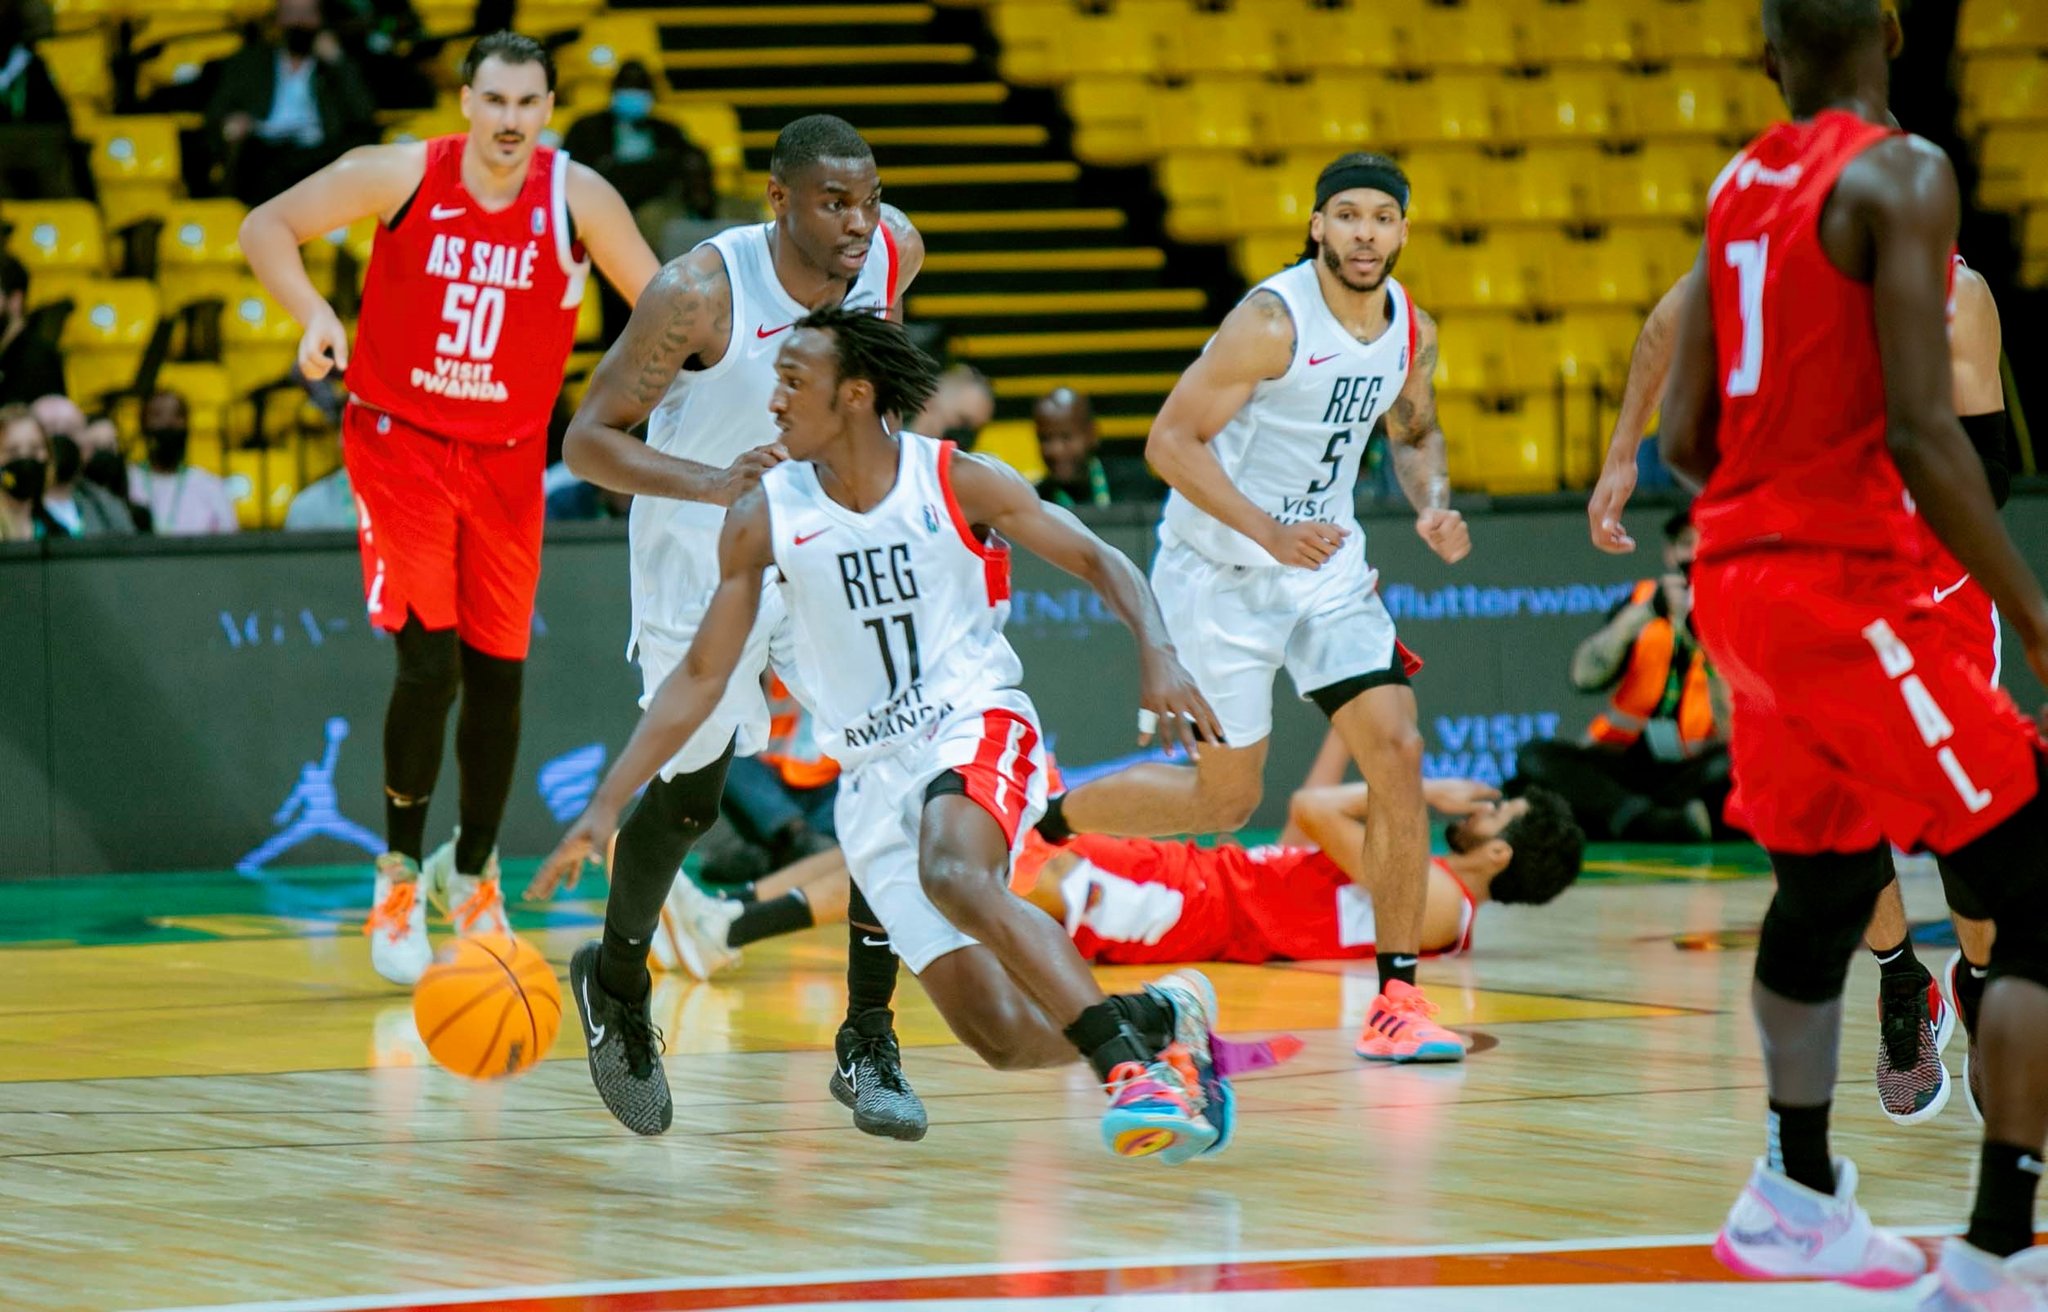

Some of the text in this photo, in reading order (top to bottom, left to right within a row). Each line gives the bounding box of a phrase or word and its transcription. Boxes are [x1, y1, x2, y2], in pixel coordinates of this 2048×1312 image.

[426, 234, 539, 289] AS SALÉ
[435, 281, 506, 360] 50
[434, 357, 493, 382] VISIT
[1322, 376, 1384, 423] REG
[1307, 428, 1352, 493] 5
[837, 543, 920, 610] REG
[863, 612, 920, 701] 11
